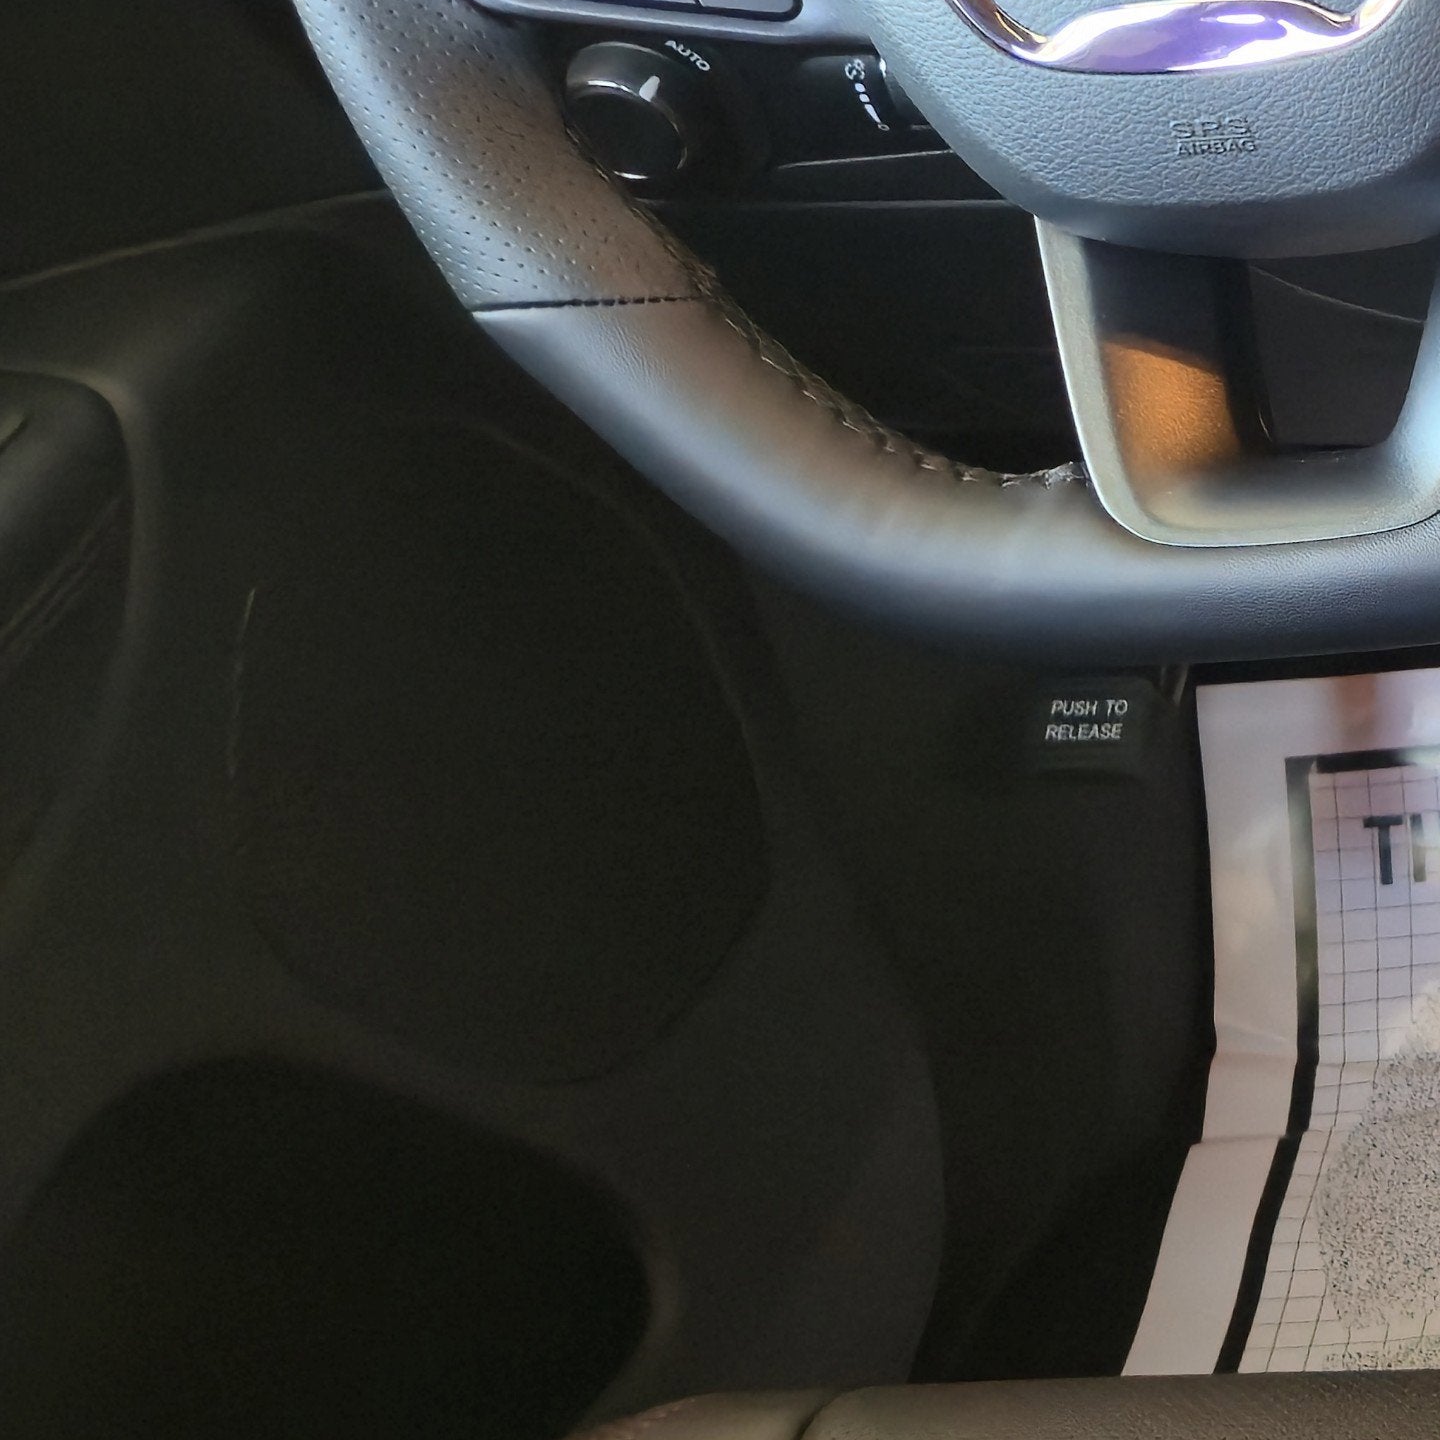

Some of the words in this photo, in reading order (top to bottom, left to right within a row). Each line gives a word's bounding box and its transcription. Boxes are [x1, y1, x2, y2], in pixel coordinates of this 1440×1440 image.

[664, 40, 713, 73] AUTO
[1177, 139, 1257, 156] AIRBAG
[1051, 699, 1098, 716] PUSH
[1106, 699, 1128, 717] TO
[1045, 723, 1123, 741] RELEASE
